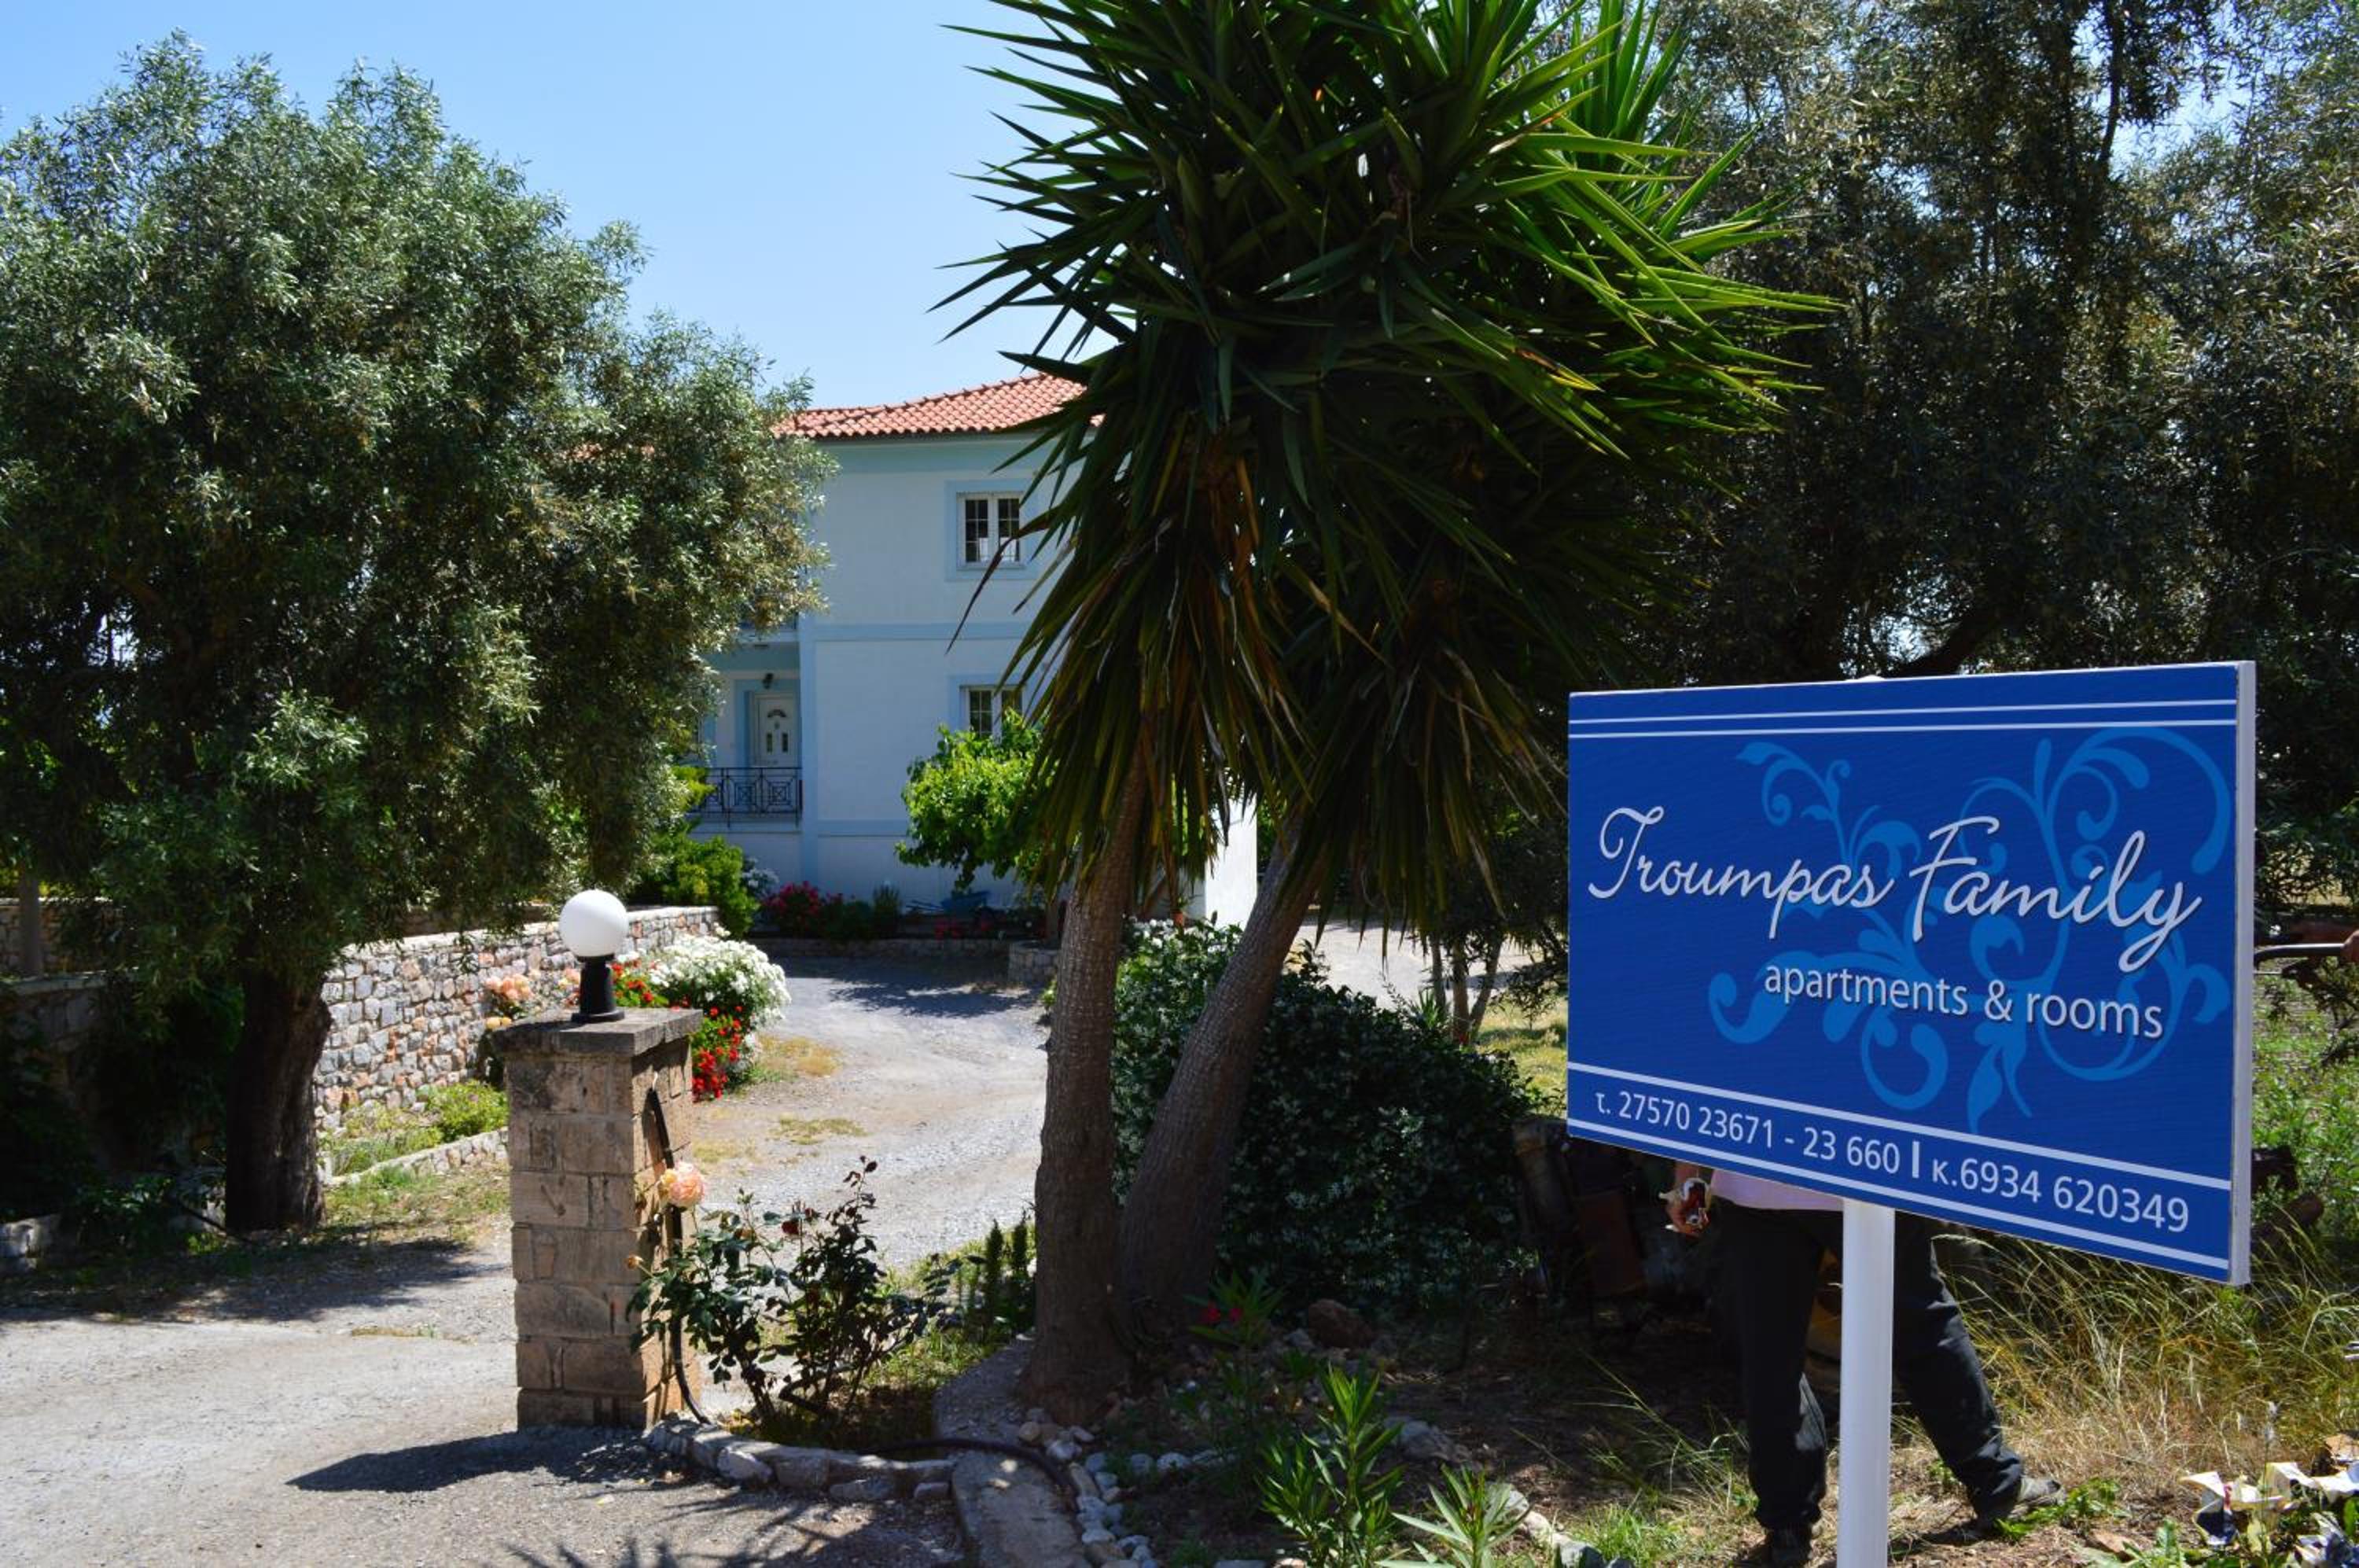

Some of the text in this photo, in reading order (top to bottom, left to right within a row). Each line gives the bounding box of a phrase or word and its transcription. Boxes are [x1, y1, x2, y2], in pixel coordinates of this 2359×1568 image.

[1588, 806, 2203, 973] Troumpas Family
[1765, 966, 2163, 1038] apartments & rooms
[1619, 1091, 1690, 1130] 27570
[1698, 1106, 1772, 1149] 23671
[1802, 1127, 1837, 1160] 23
[1846, 1136, 1901, 1174] 660
[2053, 1176, 2189, 1232] 620349
